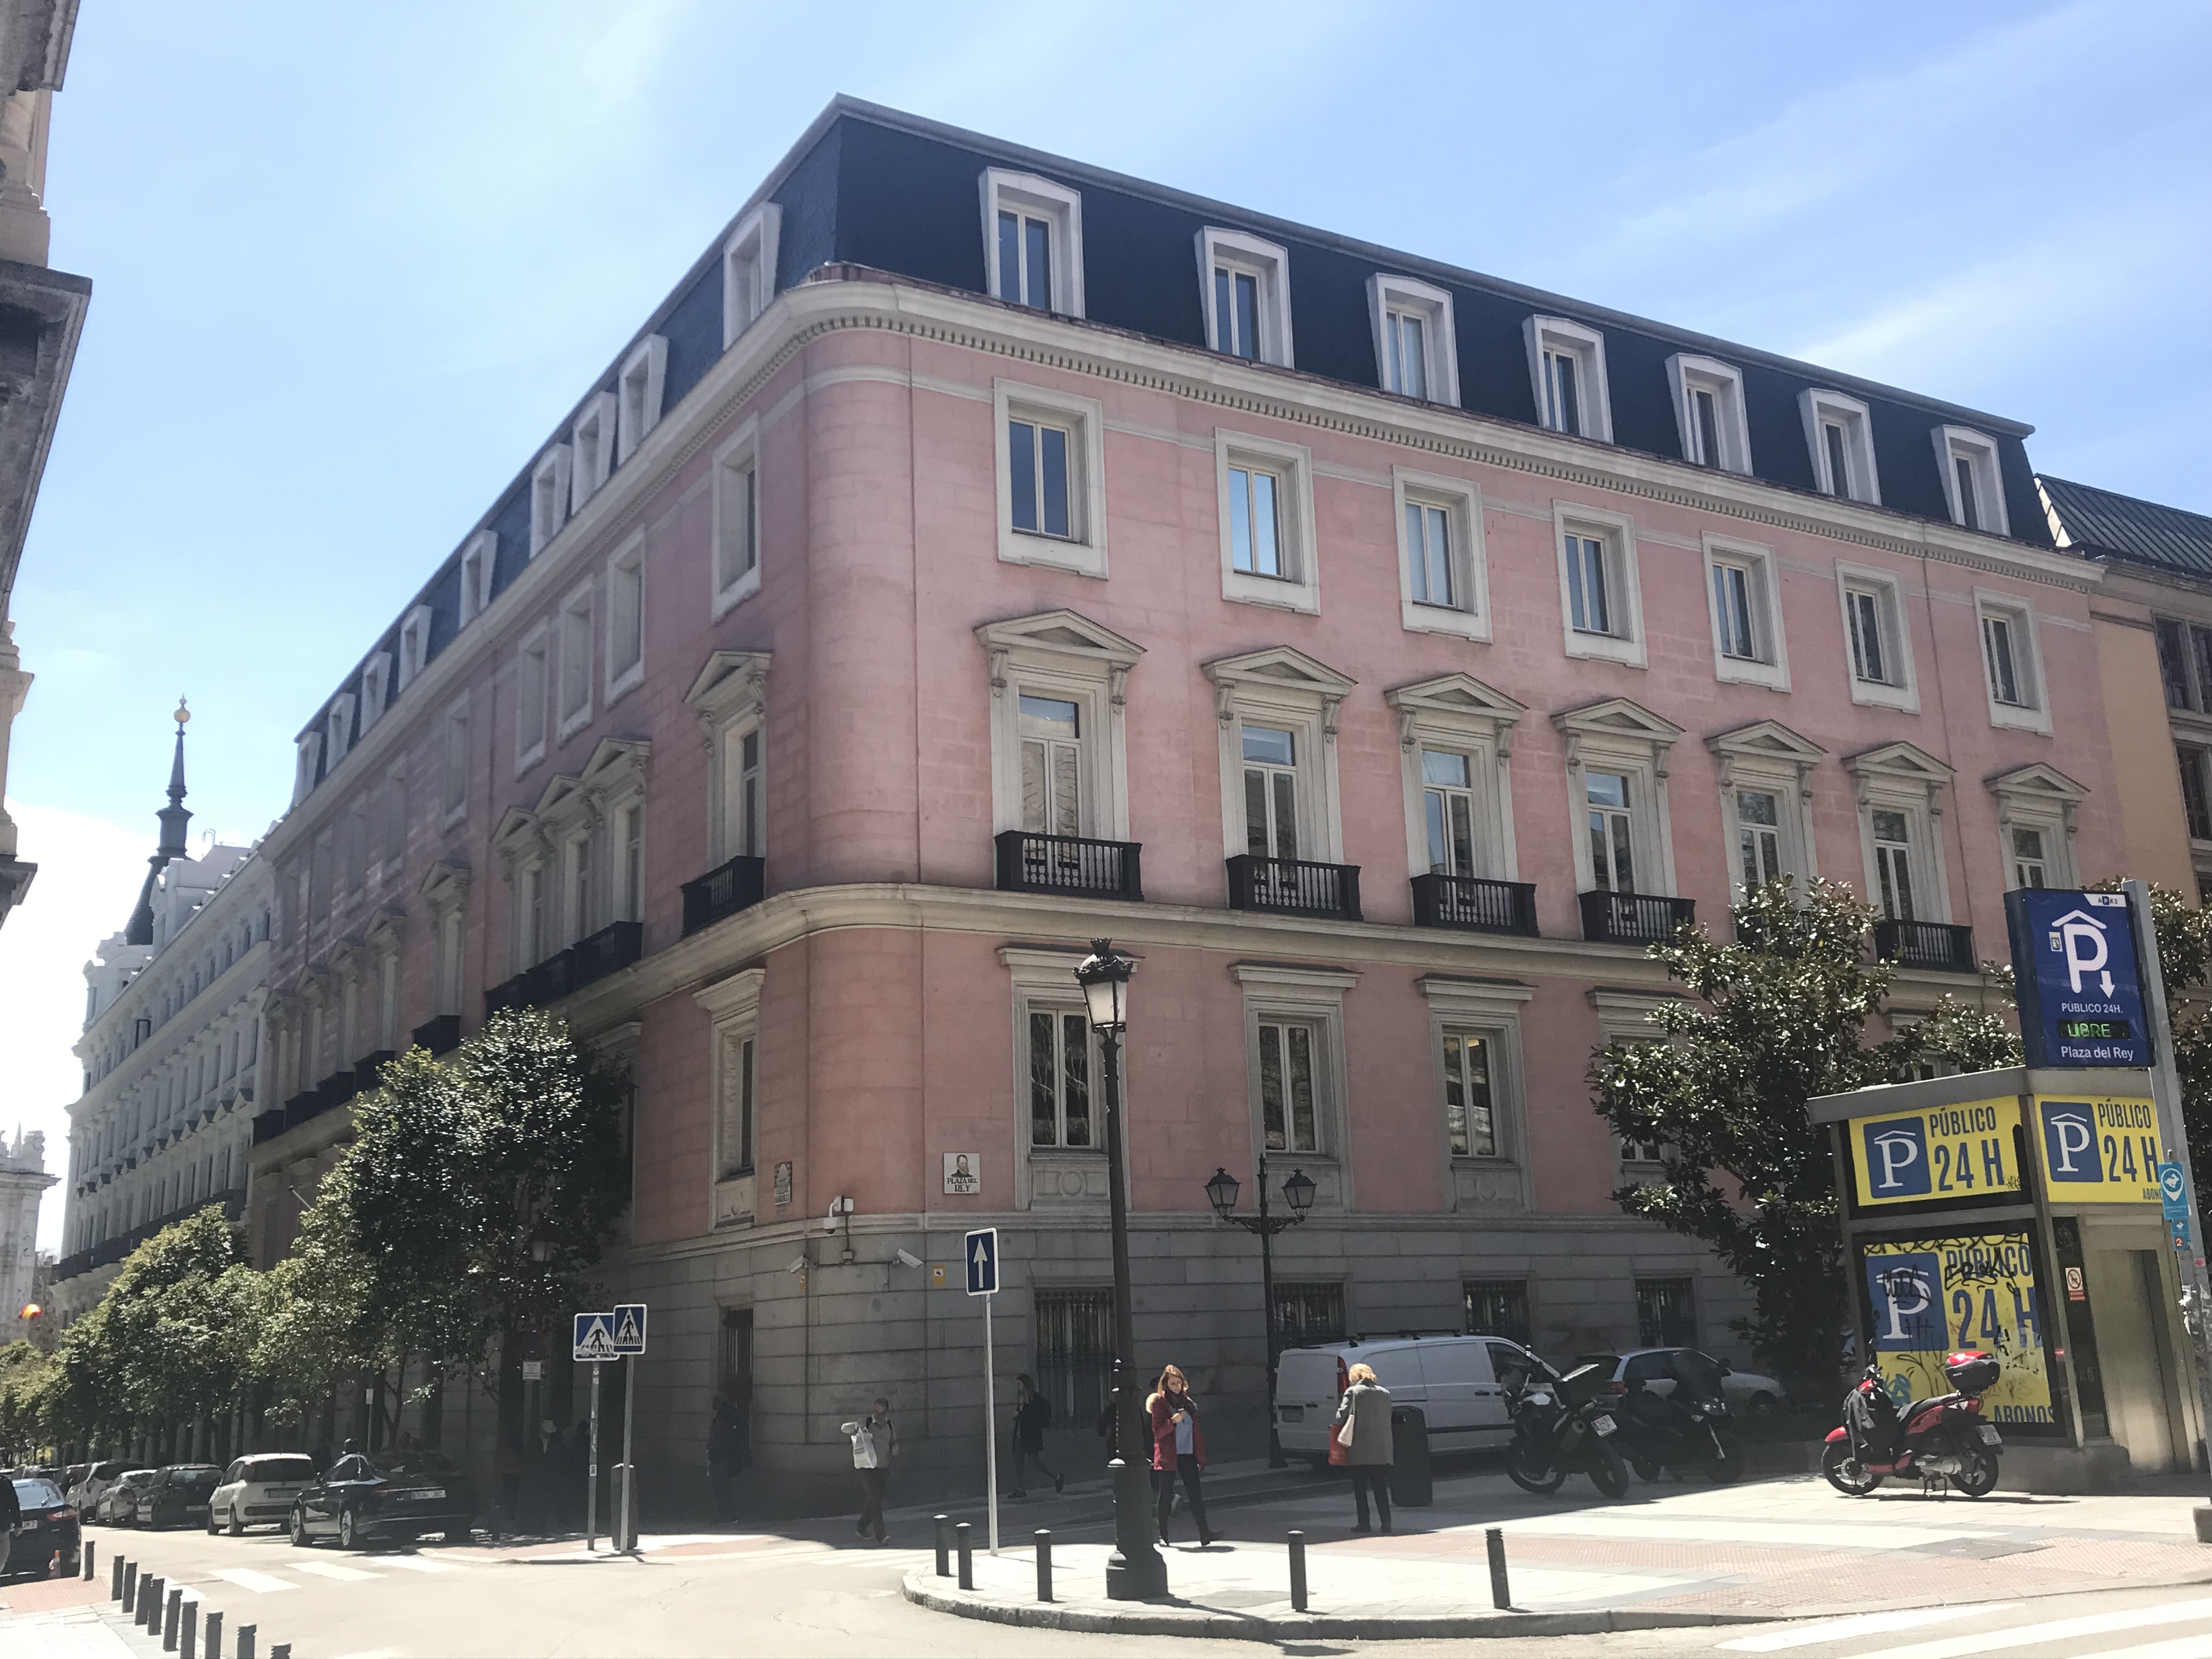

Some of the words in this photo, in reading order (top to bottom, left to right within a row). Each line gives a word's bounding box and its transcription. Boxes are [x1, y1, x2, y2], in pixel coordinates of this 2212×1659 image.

[2061, 1001, 2102, 1013] PÚBLICO
[2103, 1003, 2123, 1013] 24H.
[2067, 1023, 2112, 1037] LIBRE
[2061, 1046, 2092, 1058] Plaza
[2094, 1046, 2111, 1058] del
[2113, 1047, 2134, 1062] Rey
[1929, 1106, 1997, 1138] PÚBLICO
[2097, 1098, 2152, 1129] PÚBLICO
[2050, 1120, 2090, 1172] P
[1874, 1137, 1918, 1189] P
